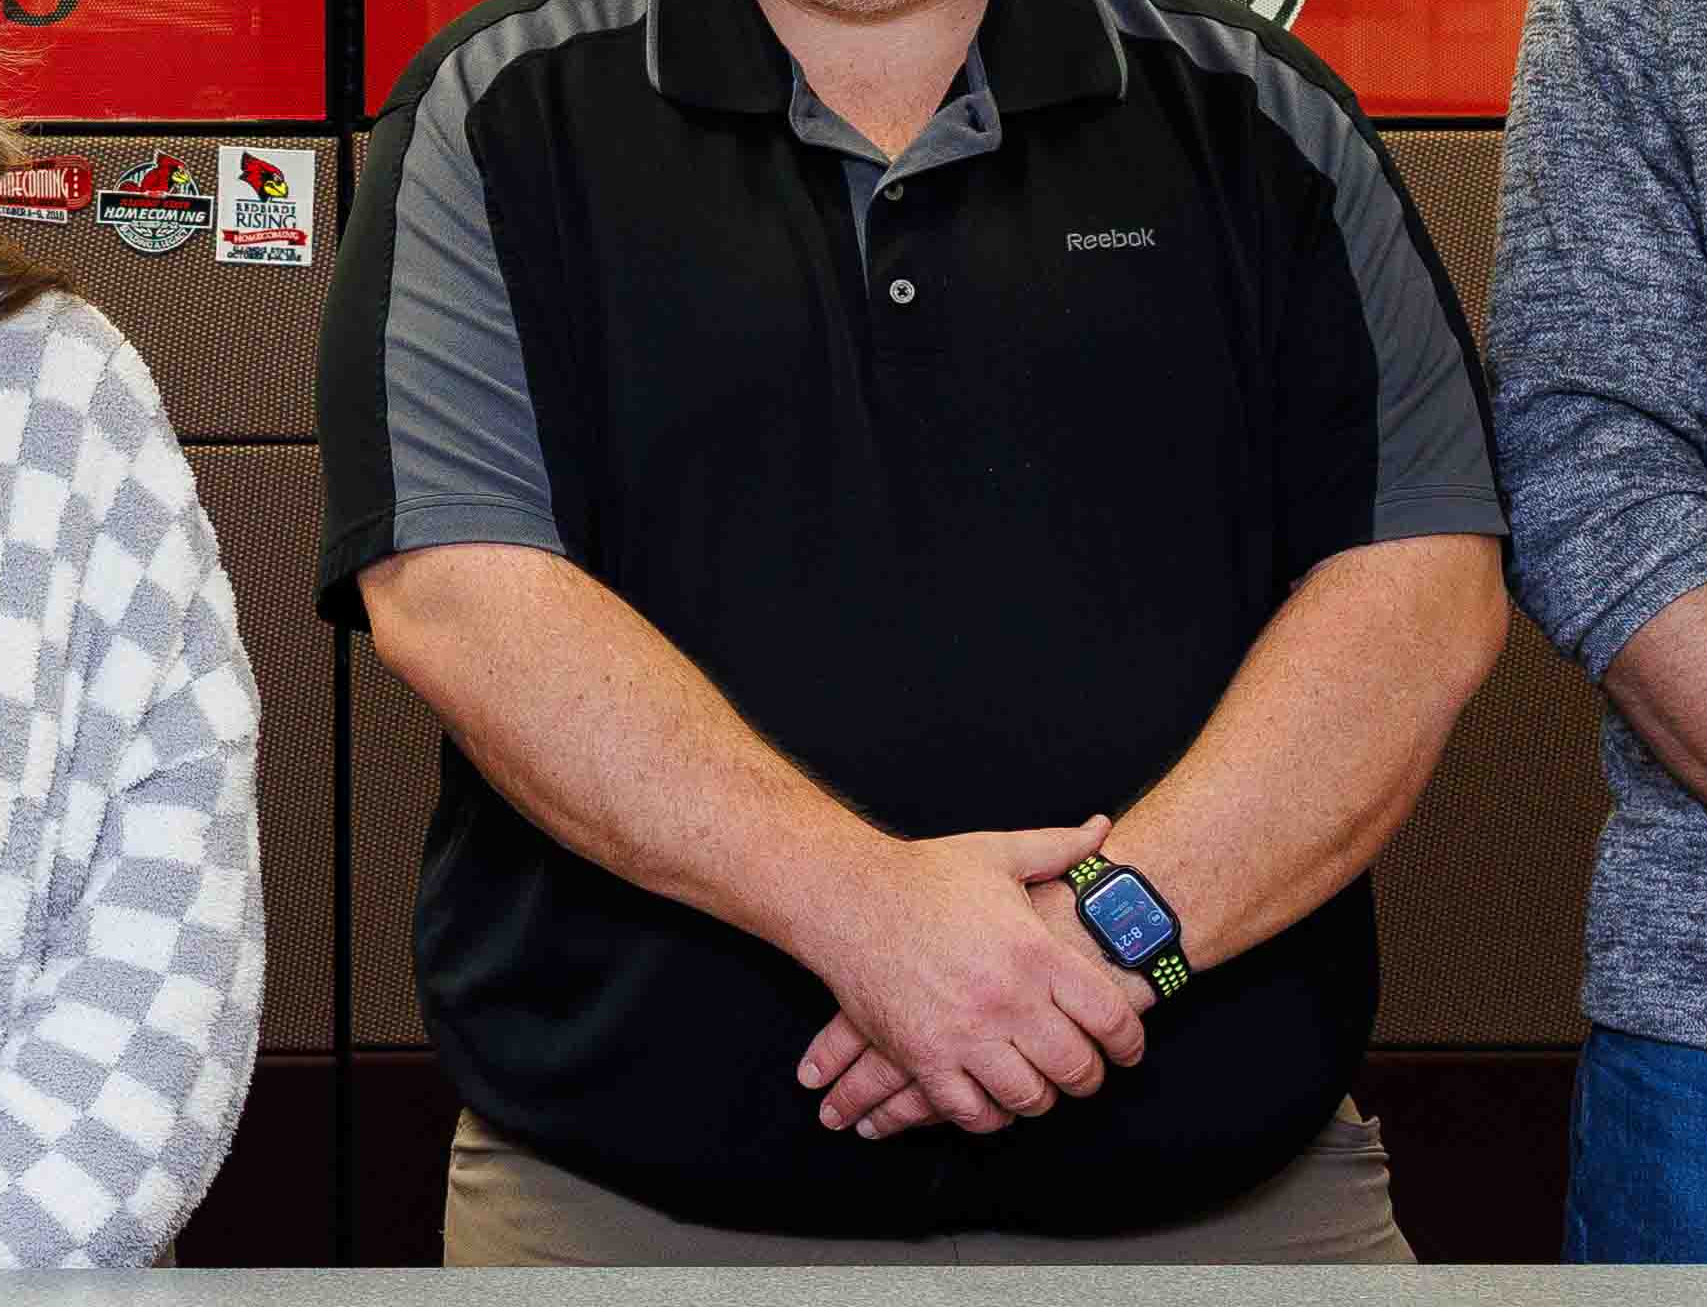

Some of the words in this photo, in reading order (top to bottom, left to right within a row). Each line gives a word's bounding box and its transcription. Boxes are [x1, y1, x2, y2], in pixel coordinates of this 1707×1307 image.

[103, 206, 207, 224] HOMECOMING
[236, 213, 297, 229] RISING
[1066, 226, 1157, 252] Reebok
